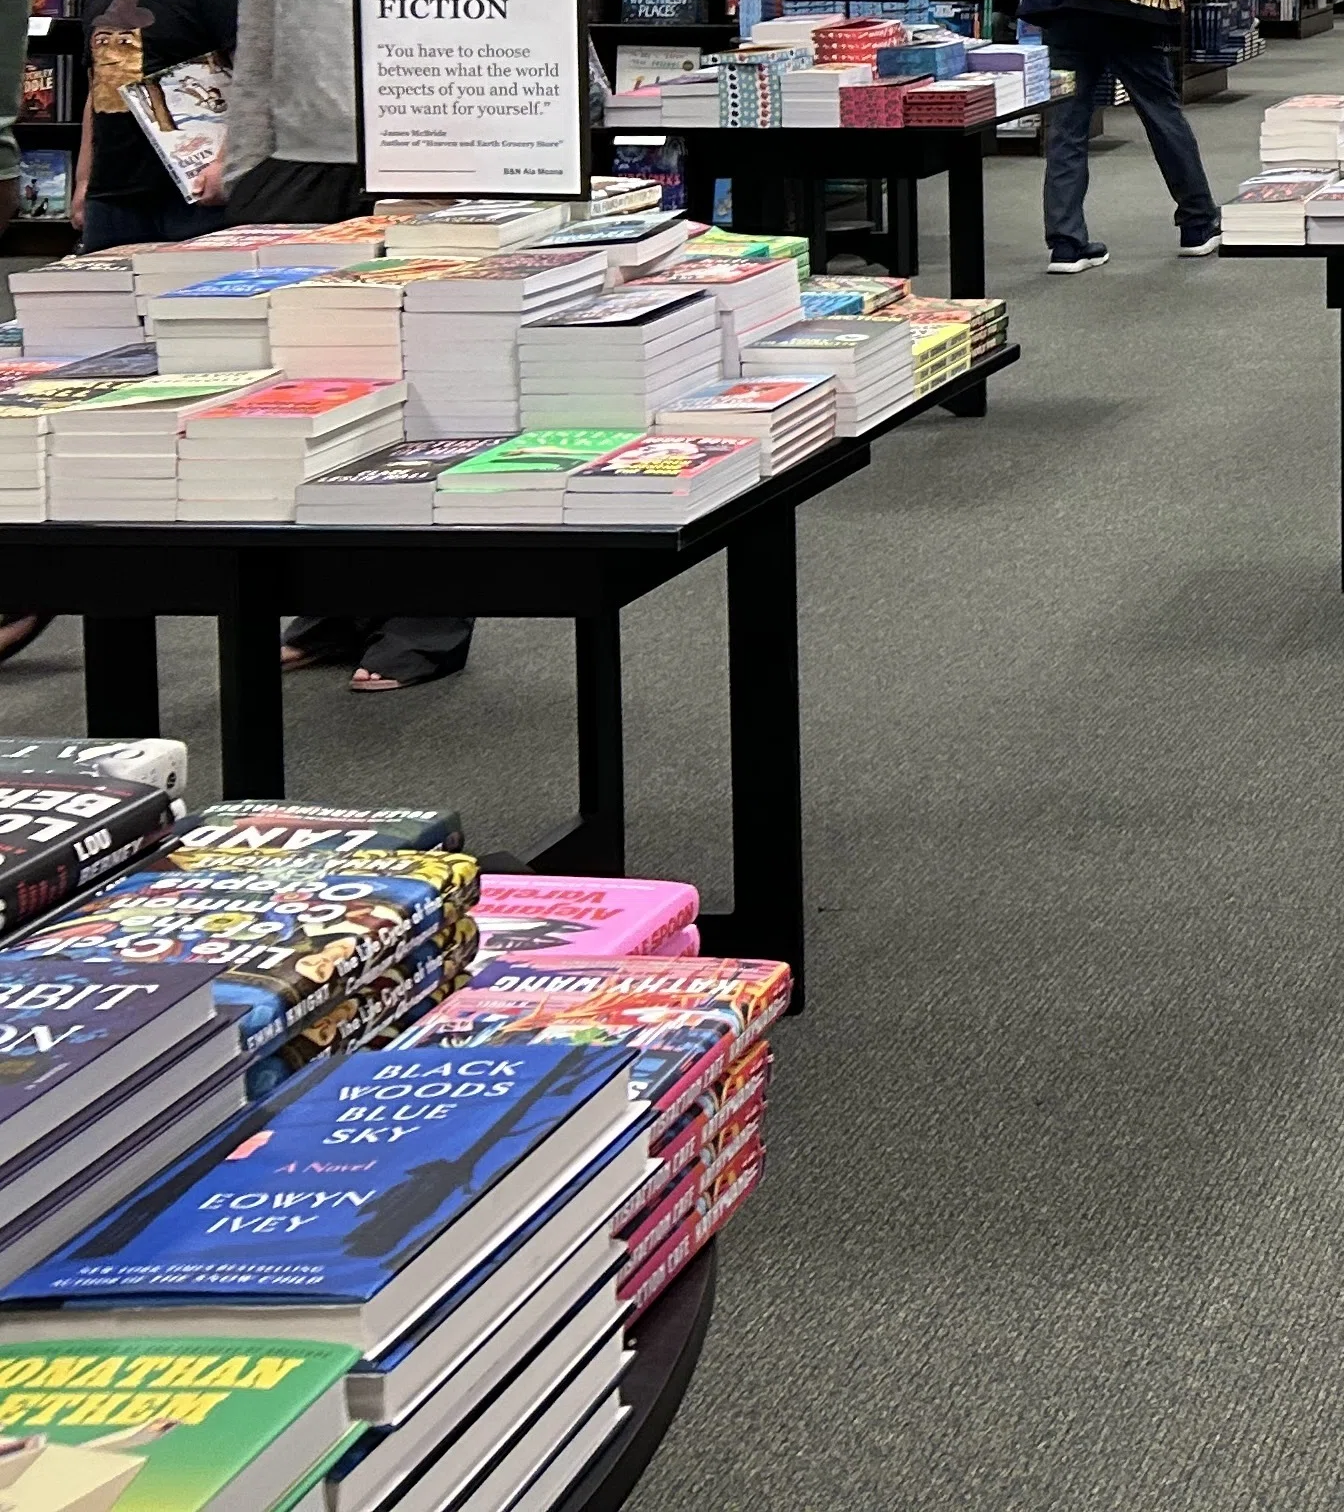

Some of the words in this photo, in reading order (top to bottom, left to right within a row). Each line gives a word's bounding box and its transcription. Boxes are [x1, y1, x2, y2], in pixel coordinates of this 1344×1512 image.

[418, 44, 454, 58] have
[458, 45, 473, 58] to
[477, 44, 530, 58] choose
[377, 63, 441, 77] between
[445, 63, 483, 77] what
[487, 63, 511, 77] the
[516, 63, 559, 77] world
[378, 84, 434, 98] expects
[438, 82, 455, 96] of
[457, 86, 485, 98] you
[489, 83, 518, 96] and
[522, 82, 559, 96] what
[378, 105, 407, 118] you
[411, 105, 448, 116] want
[453, 102, 475, 116] for
[372, 1060, 525, 1081] BLACK
[339, 1081, 515, 1100] WOODS
[336, 1103, 457, 1123] BLUE
[322, 1126, 421, 1144] SKY
[273, 1163, 298, 1173] A
[302, 1160, 379, 1173] Novel
[198, 1190, 377, 1210] EOWYN
[206, 1215, 319, 1233] IVEY
